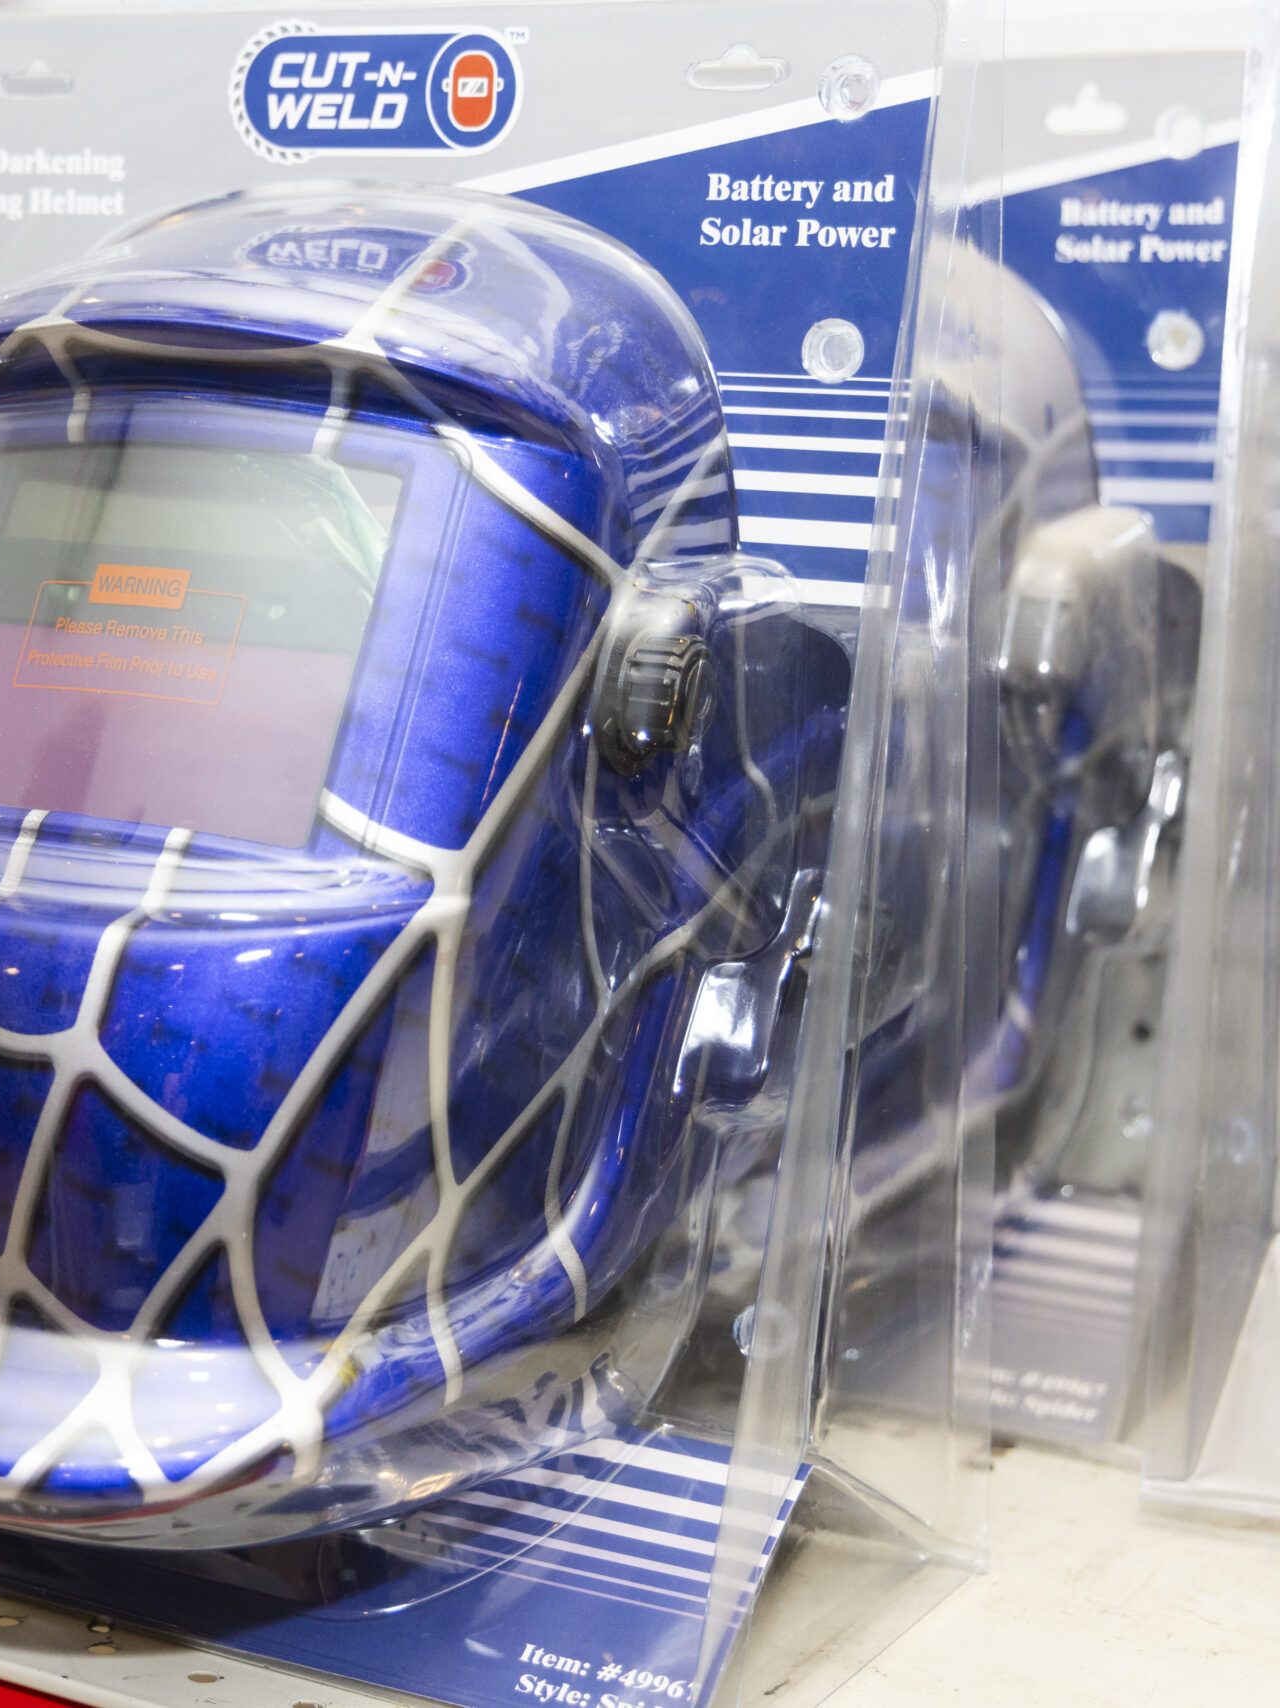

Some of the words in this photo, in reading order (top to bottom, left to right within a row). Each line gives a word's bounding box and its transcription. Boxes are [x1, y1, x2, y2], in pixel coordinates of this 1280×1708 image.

[269, 52, 417, 88] CUT-N-
[267, 93, 408, 130] WELD
[29, 188, 125, 215] Helmet
[706, 173, 824, 209] Battery
[832, 174, 895, 202] and
[1060, 198, 1163, 231] Battery
[1168, 197, 1224, 225] and
[700, 217, 788, 246] Solar
[794, 218, 897, 248] Power
[1055, 234, 1134, 263] Solar
[1139, 234, 1228, 263] Power
[98, 575, 182, 598] WARNING
[55, 617, 103, 635] Please
[105, 620, 167, 640] Remove
[172, 625, 204, 645] This
[27, 649, 94, 669] Protective
[96, 653, 128, 671] Film
[129, 656, 165, 675] Prior
[168, 661, 184, 676] to
[186, 663, 217, 681] Use
[518, 1643, 591, 1676] Item:
[514, 1673, 591, 1707] Style:
